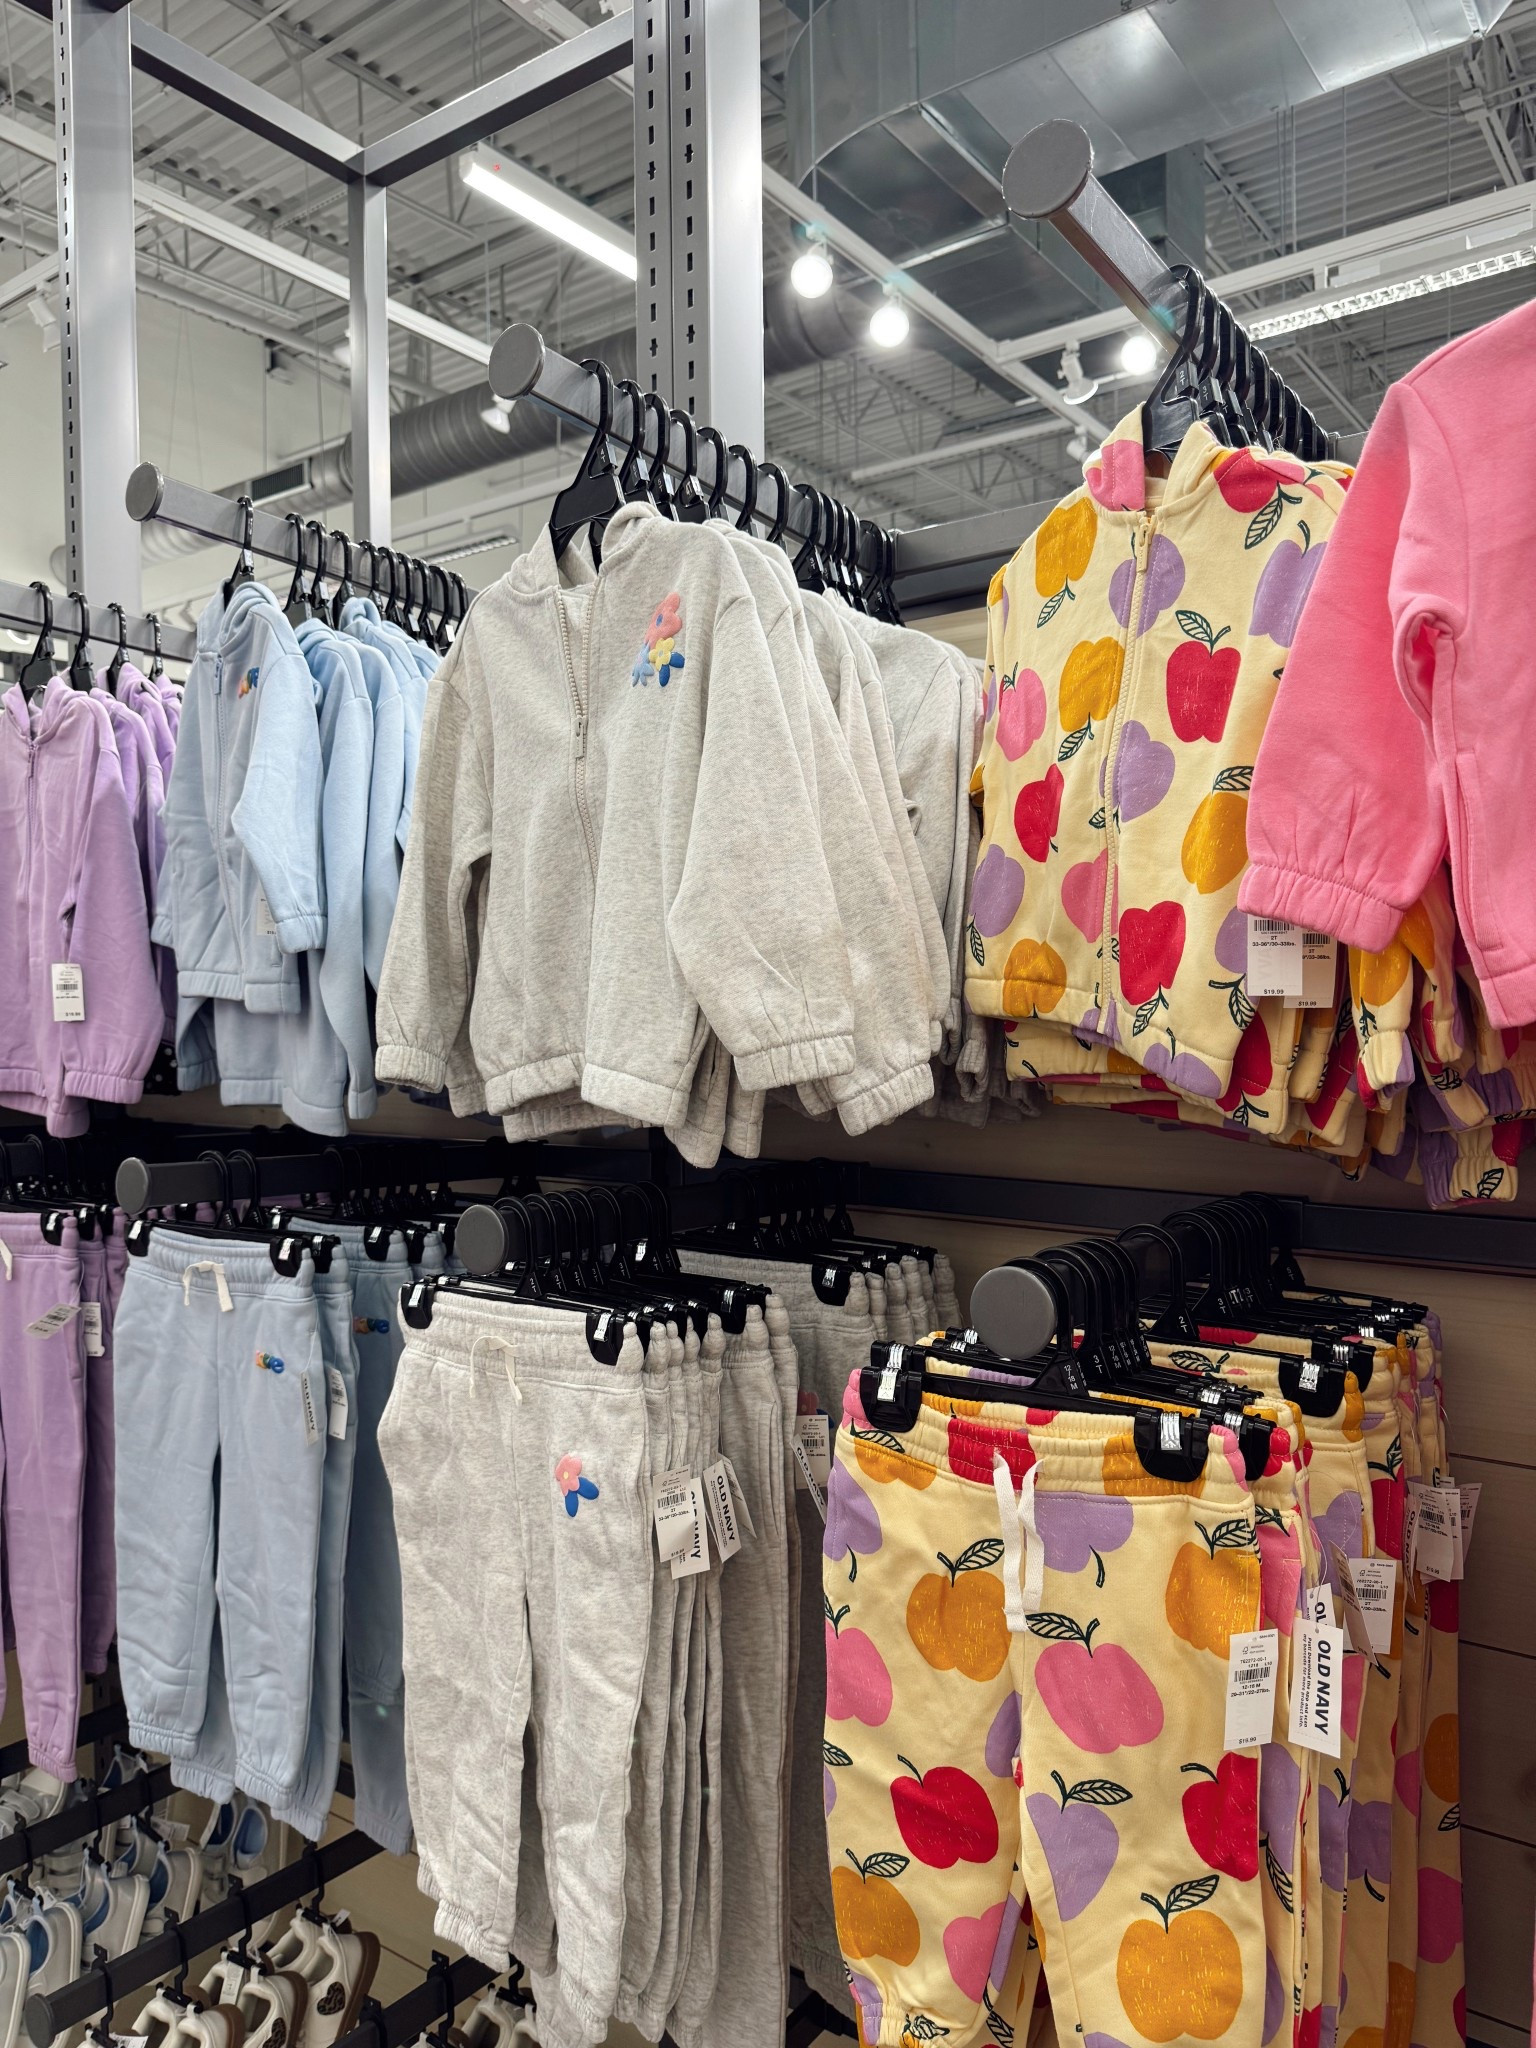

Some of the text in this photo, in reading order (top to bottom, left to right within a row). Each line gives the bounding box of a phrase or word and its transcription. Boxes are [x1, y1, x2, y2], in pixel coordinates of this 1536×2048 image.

[717, 1475, 727, 1502] OLD
[723, 1503, 735, 1541] NAVY
[1314, 1639, 1332, 1736] OLD NAVY
[1238, 1736, 1257, 1745] $19.99
